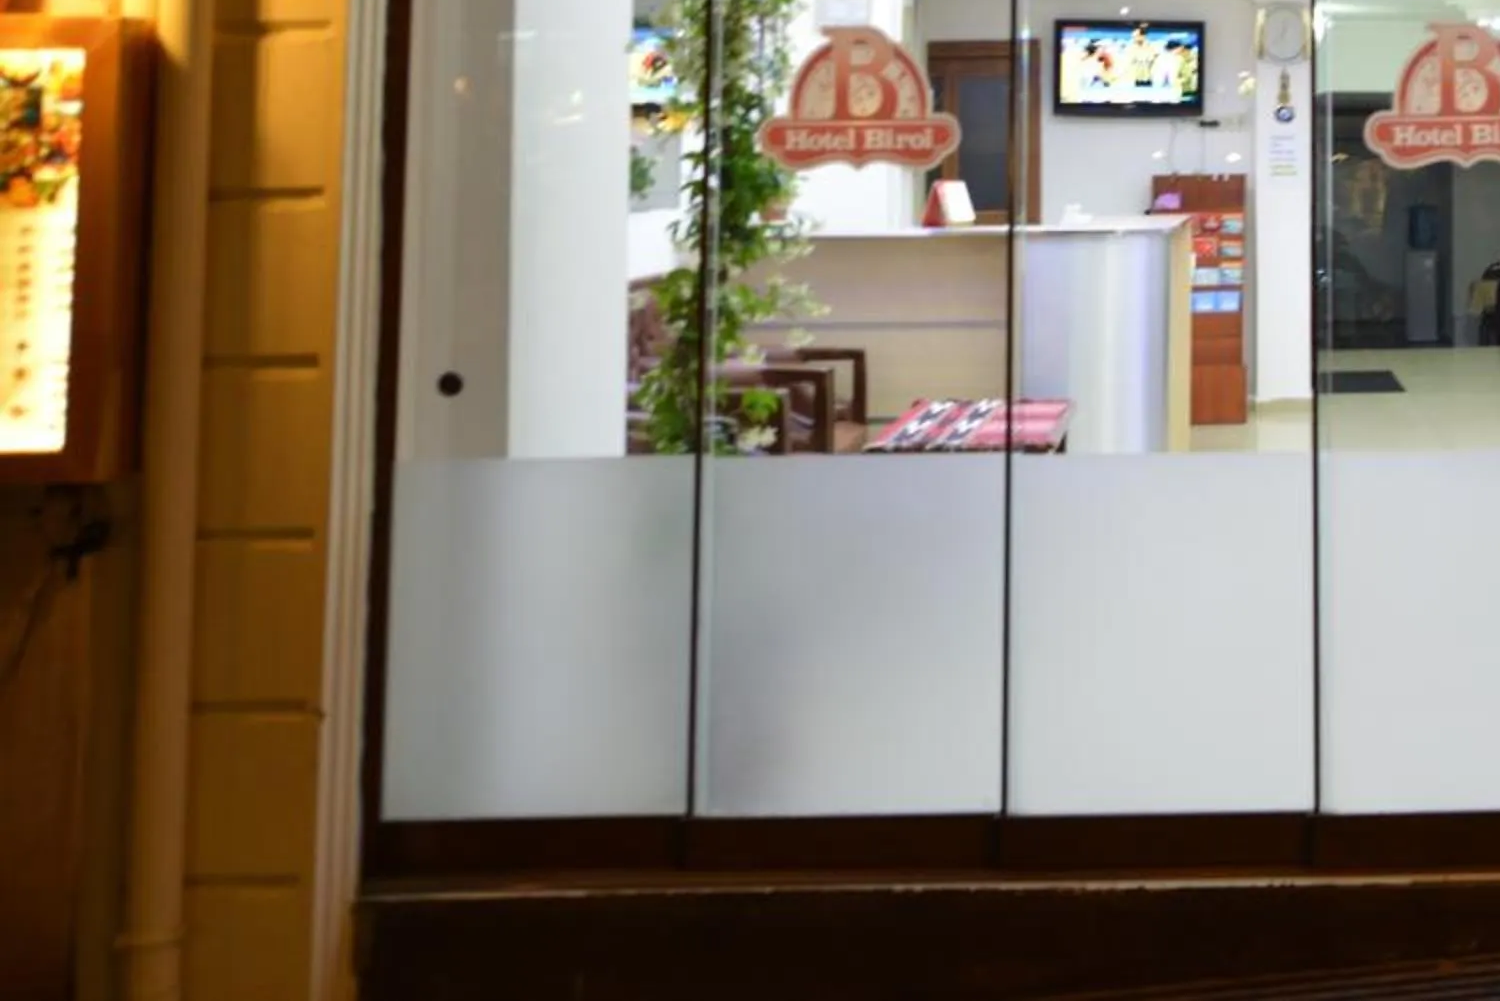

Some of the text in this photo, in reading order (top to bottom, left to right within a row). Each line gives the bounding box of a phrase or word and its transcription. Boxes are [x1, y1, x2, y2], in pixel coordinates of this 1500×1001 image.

[821, 26, 898, 120] B
[785, 127, 934, 150] Hotel Birol
[1392, 123, 1463, 147] Hotel
